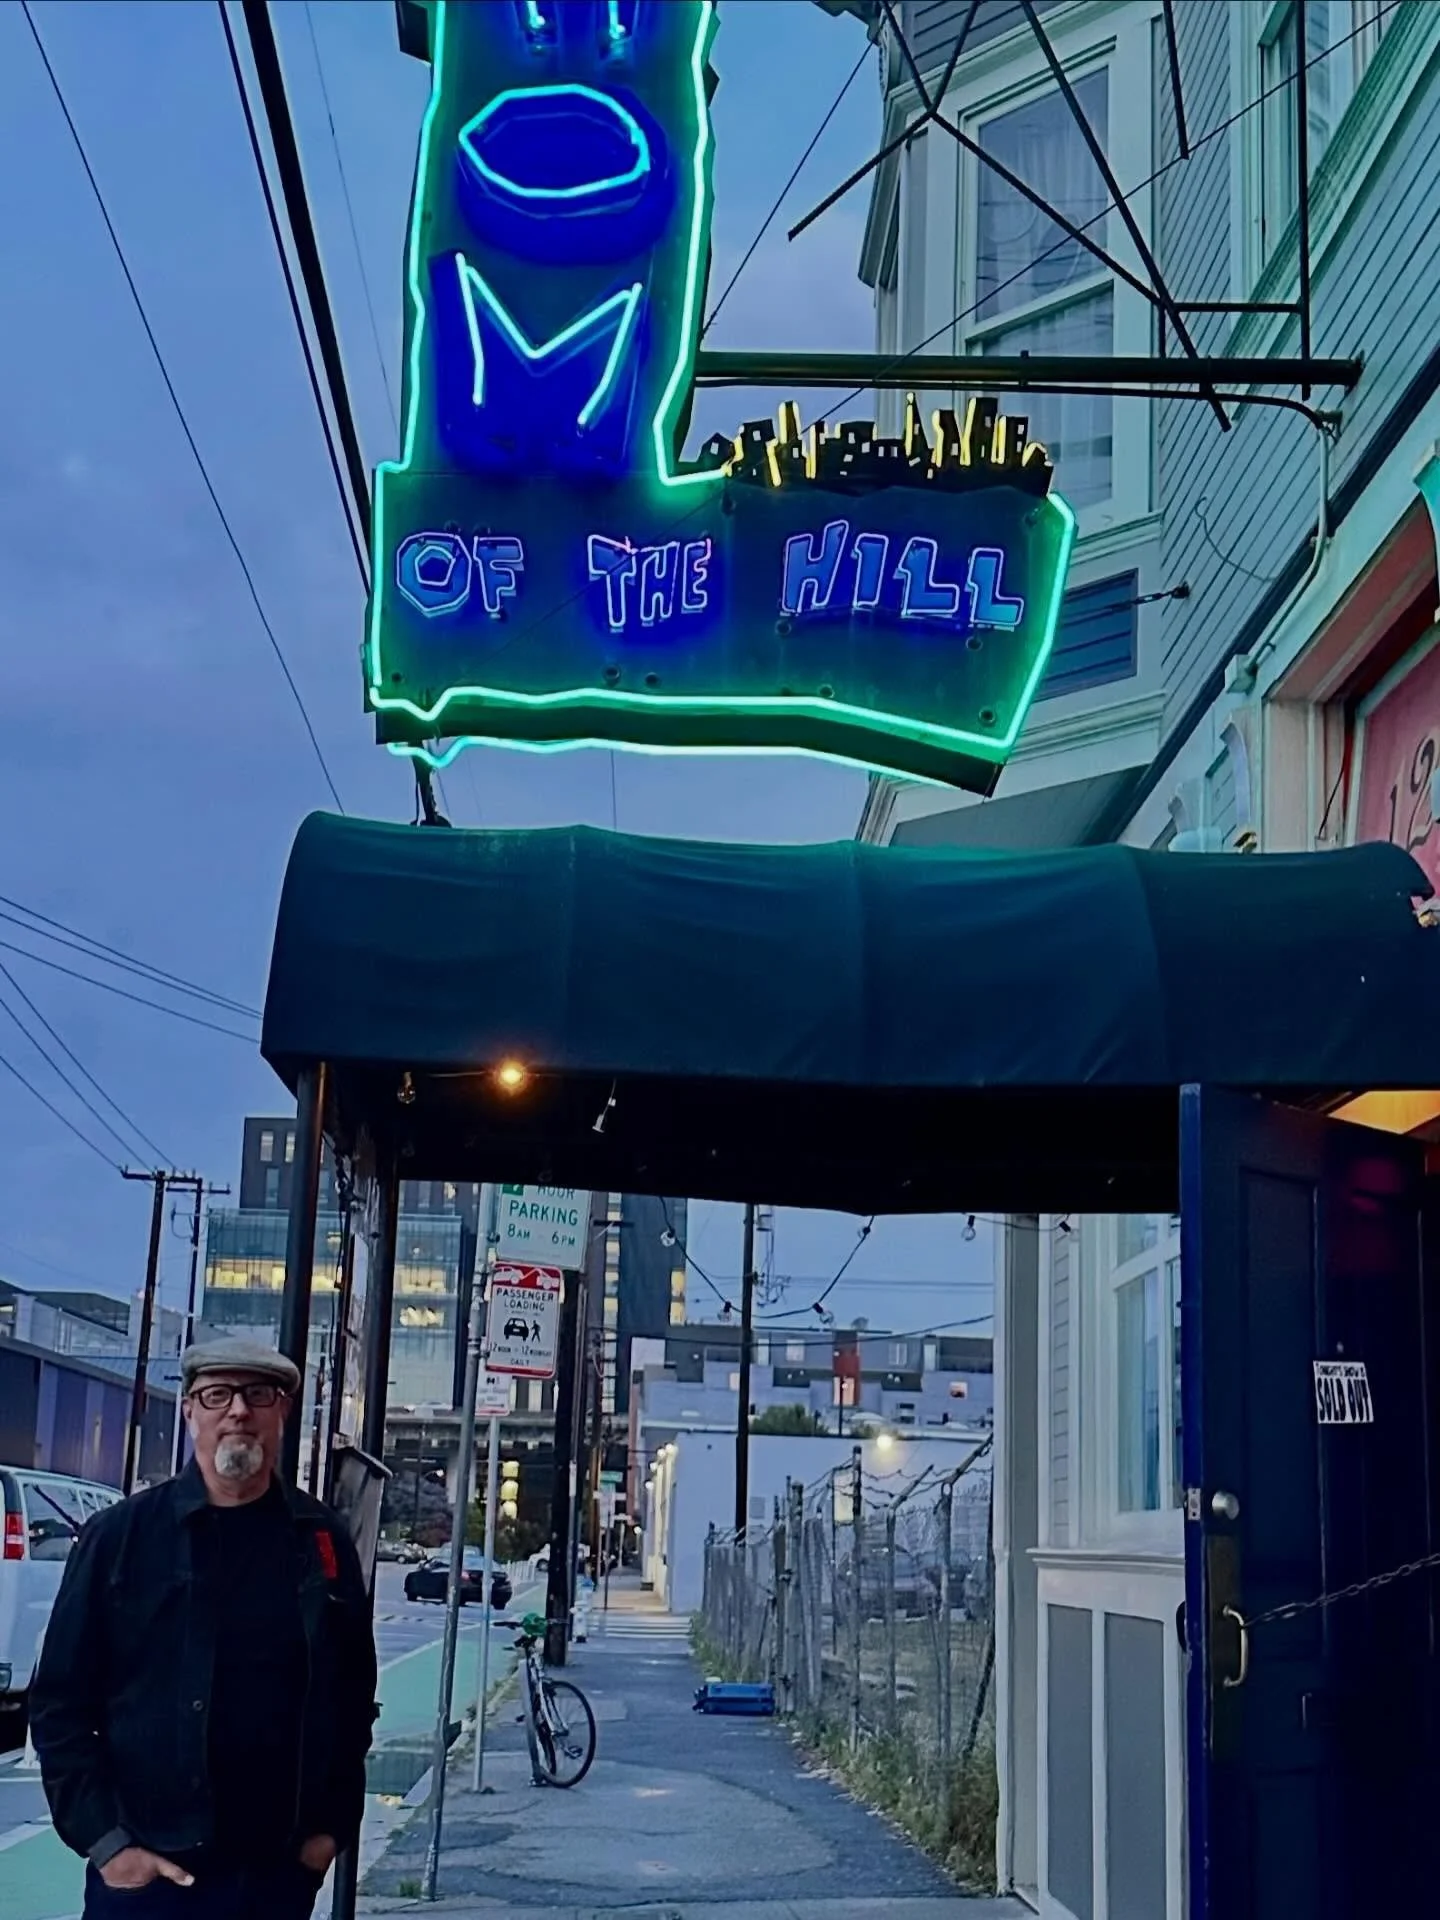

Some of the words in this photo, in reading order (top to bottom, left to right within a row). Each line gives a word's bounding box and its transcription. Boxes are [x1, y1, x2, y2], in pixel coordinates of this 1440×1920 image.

[396, 530, 525, 618] OF
[588, 533, 712, 631] THE
[780, 519, 1024, 632] HILL
[509, 1199, 578, 1226] PARKING
[496, 1287, 554, 1302] PASSENGER
[504, 1299, 545, 1312] LOADING
[1317, 1377, 1347, 1422] SOLD
[1347, 1378, 1371, 1422] OUT
